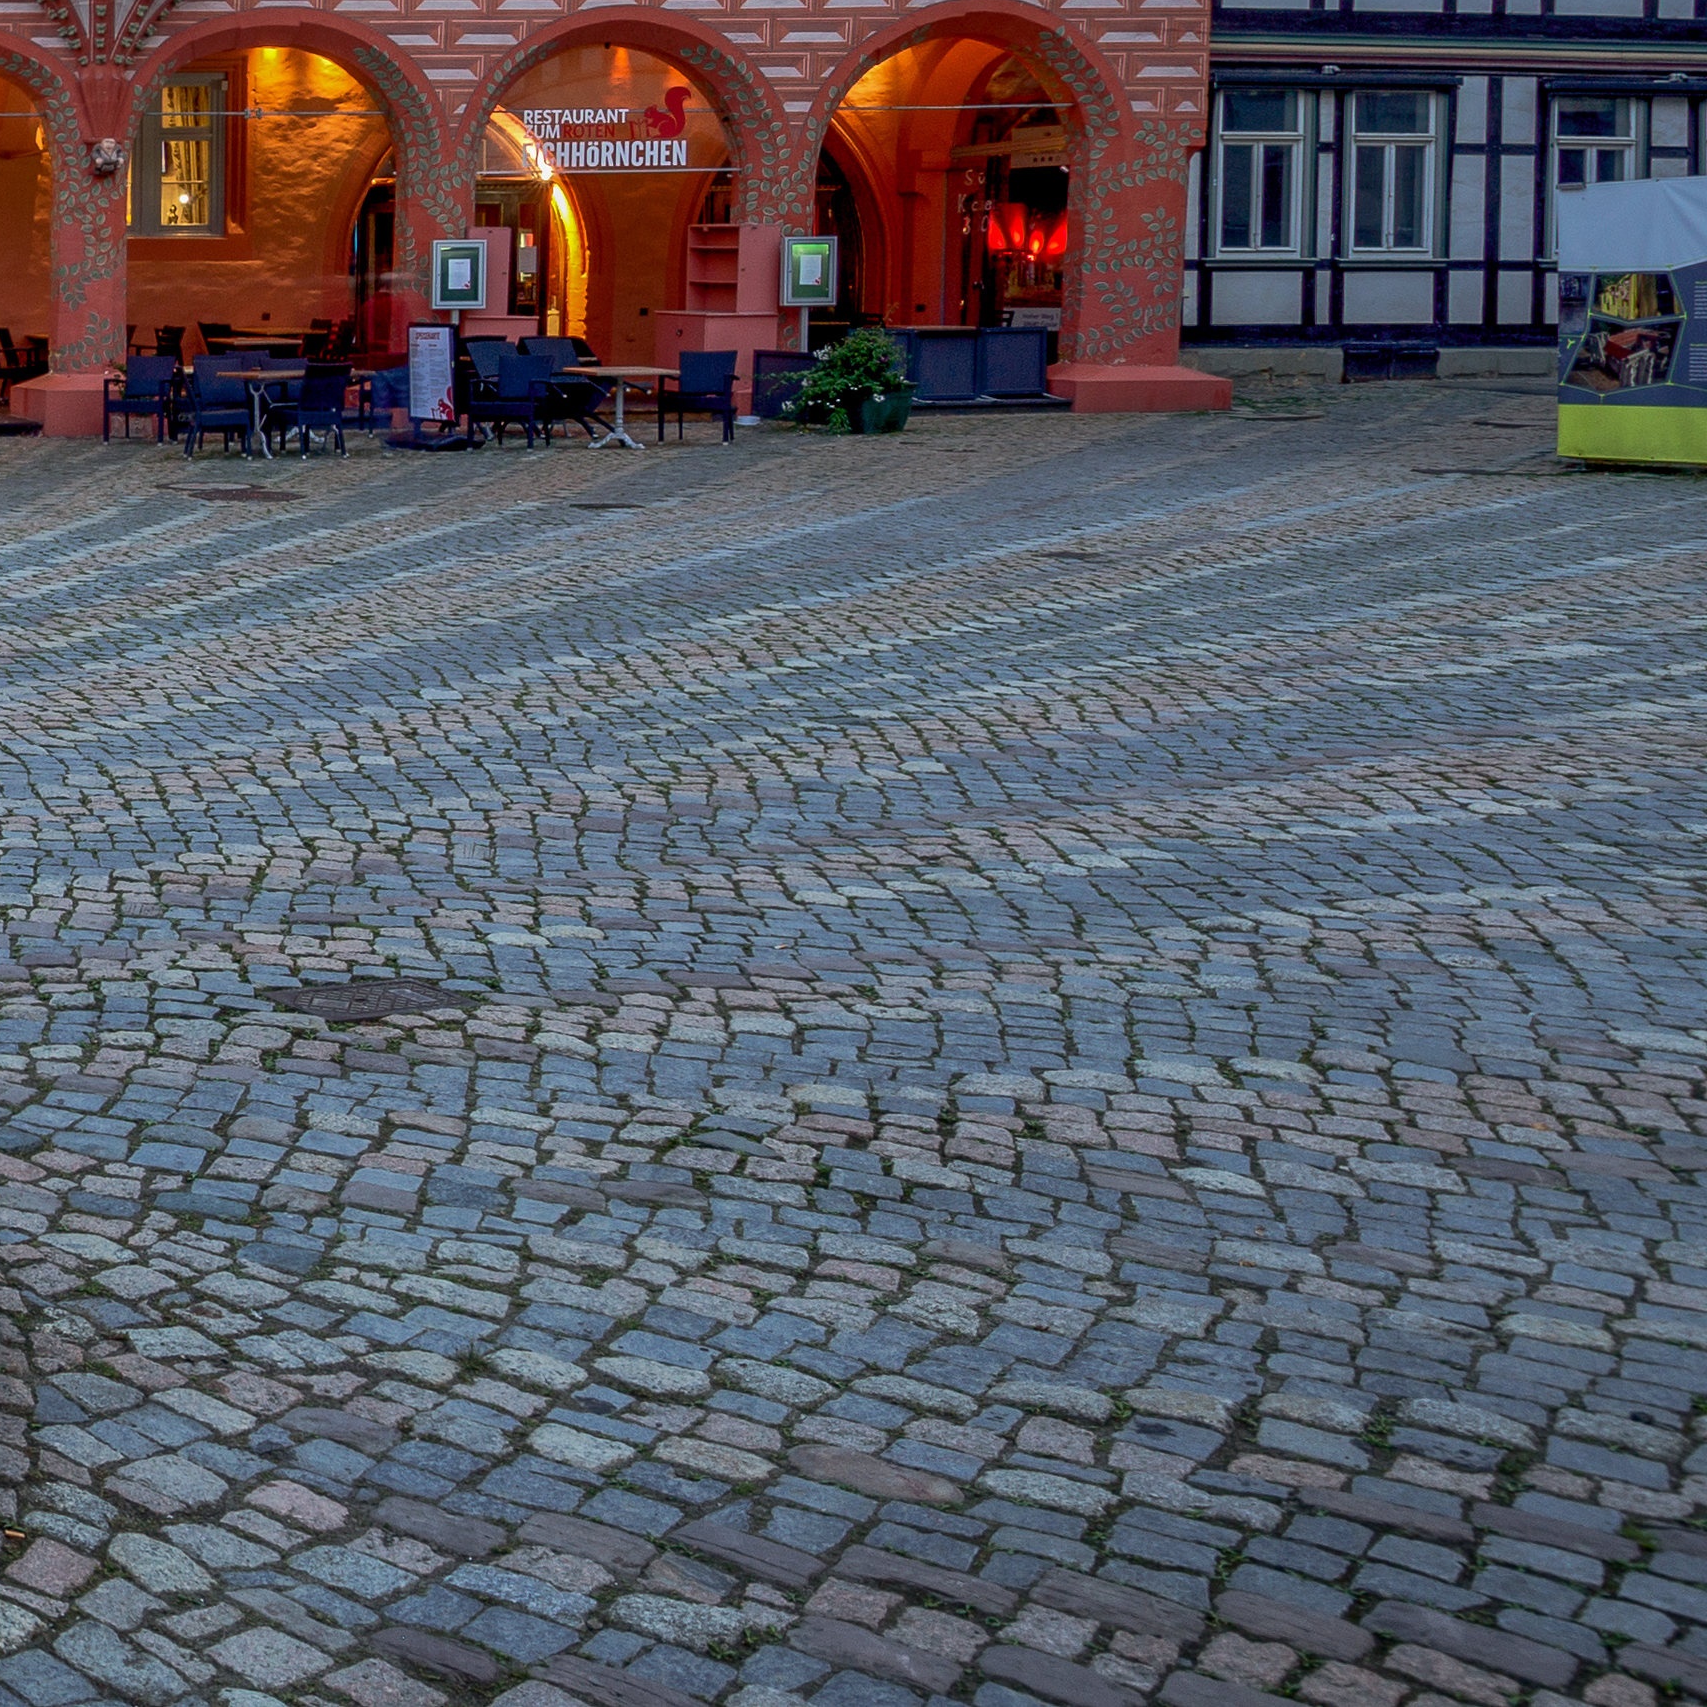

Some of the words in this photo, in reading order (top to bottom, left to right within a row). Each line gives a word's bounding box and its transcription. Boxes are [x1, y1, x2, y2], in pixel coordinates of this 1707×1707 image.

[523, 108, 629, 124] RESTAURANT
[523, 124, 561, 139] ZUM
[563, 123, 616, 139] ROTEN
